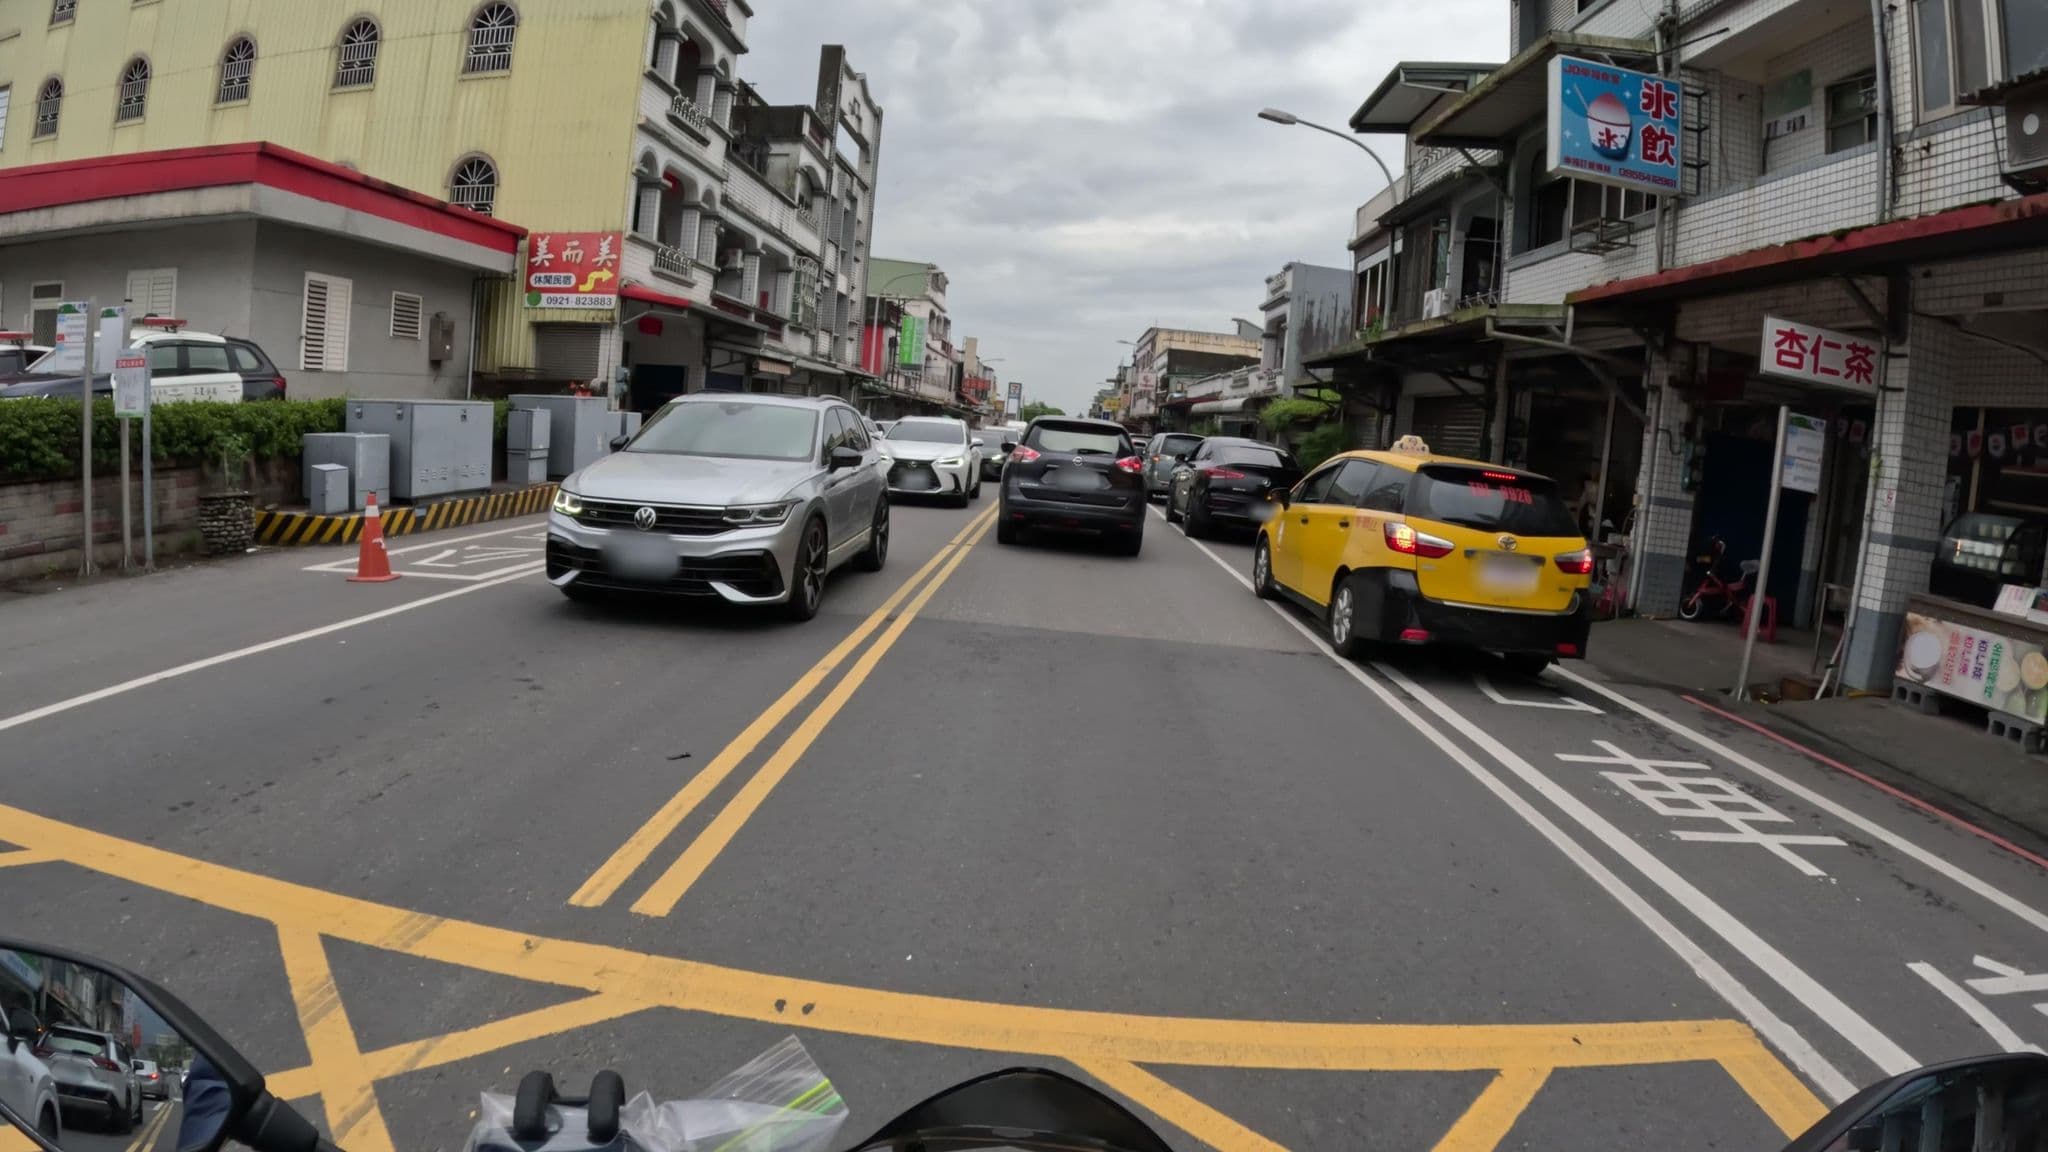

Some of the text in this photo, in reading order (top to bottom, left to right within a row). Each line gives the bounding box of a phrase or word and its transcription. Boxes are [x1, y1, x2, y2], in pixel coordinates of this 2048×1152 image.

[530, 235, 618, 267] 美而美
[546, 296, 612, 306] 0921 823883
[1774, 327, 1876, 385] 杏仁茶
